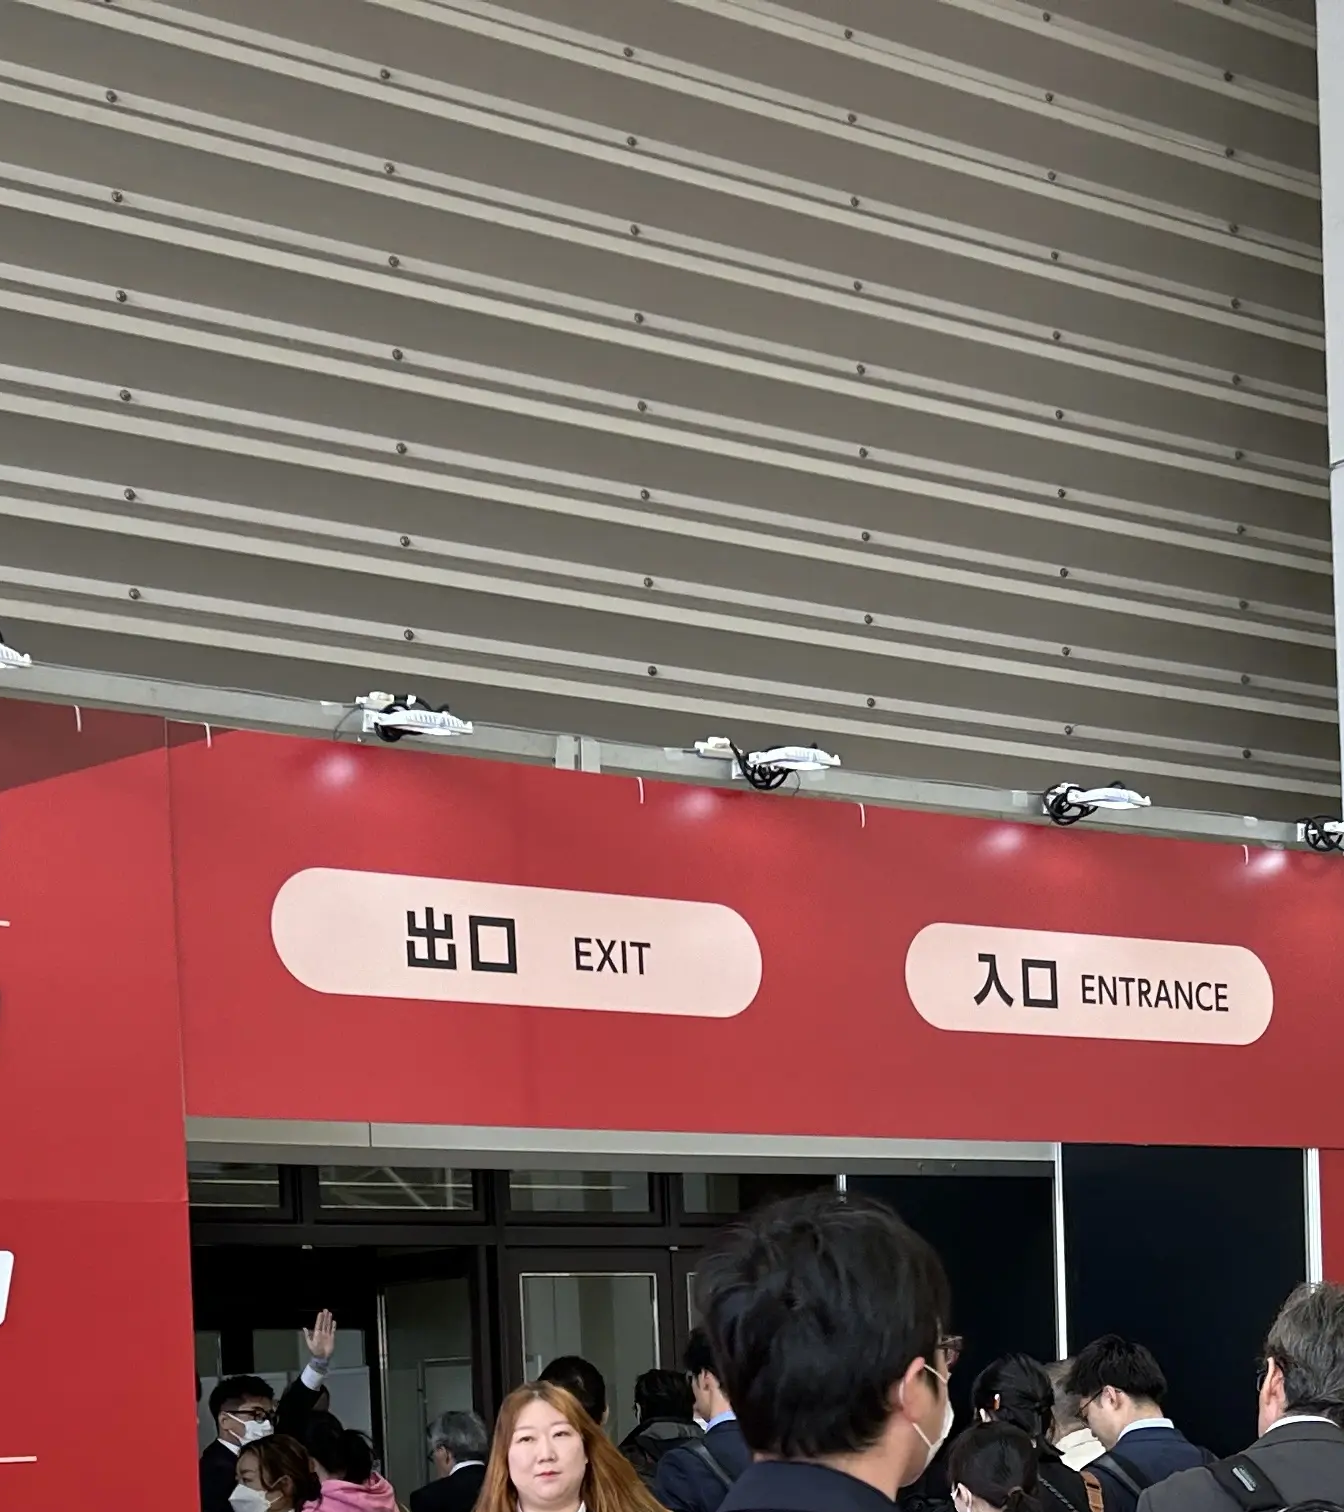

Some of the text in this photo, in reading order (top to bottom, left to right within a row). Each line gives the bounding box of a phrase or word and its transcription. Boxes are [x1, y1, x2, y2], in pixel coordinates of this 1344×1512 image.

[406, 906, 651, 975] 出口 EXIT
[974, 952, 1230, 1012] 入口 ENTRANCE
